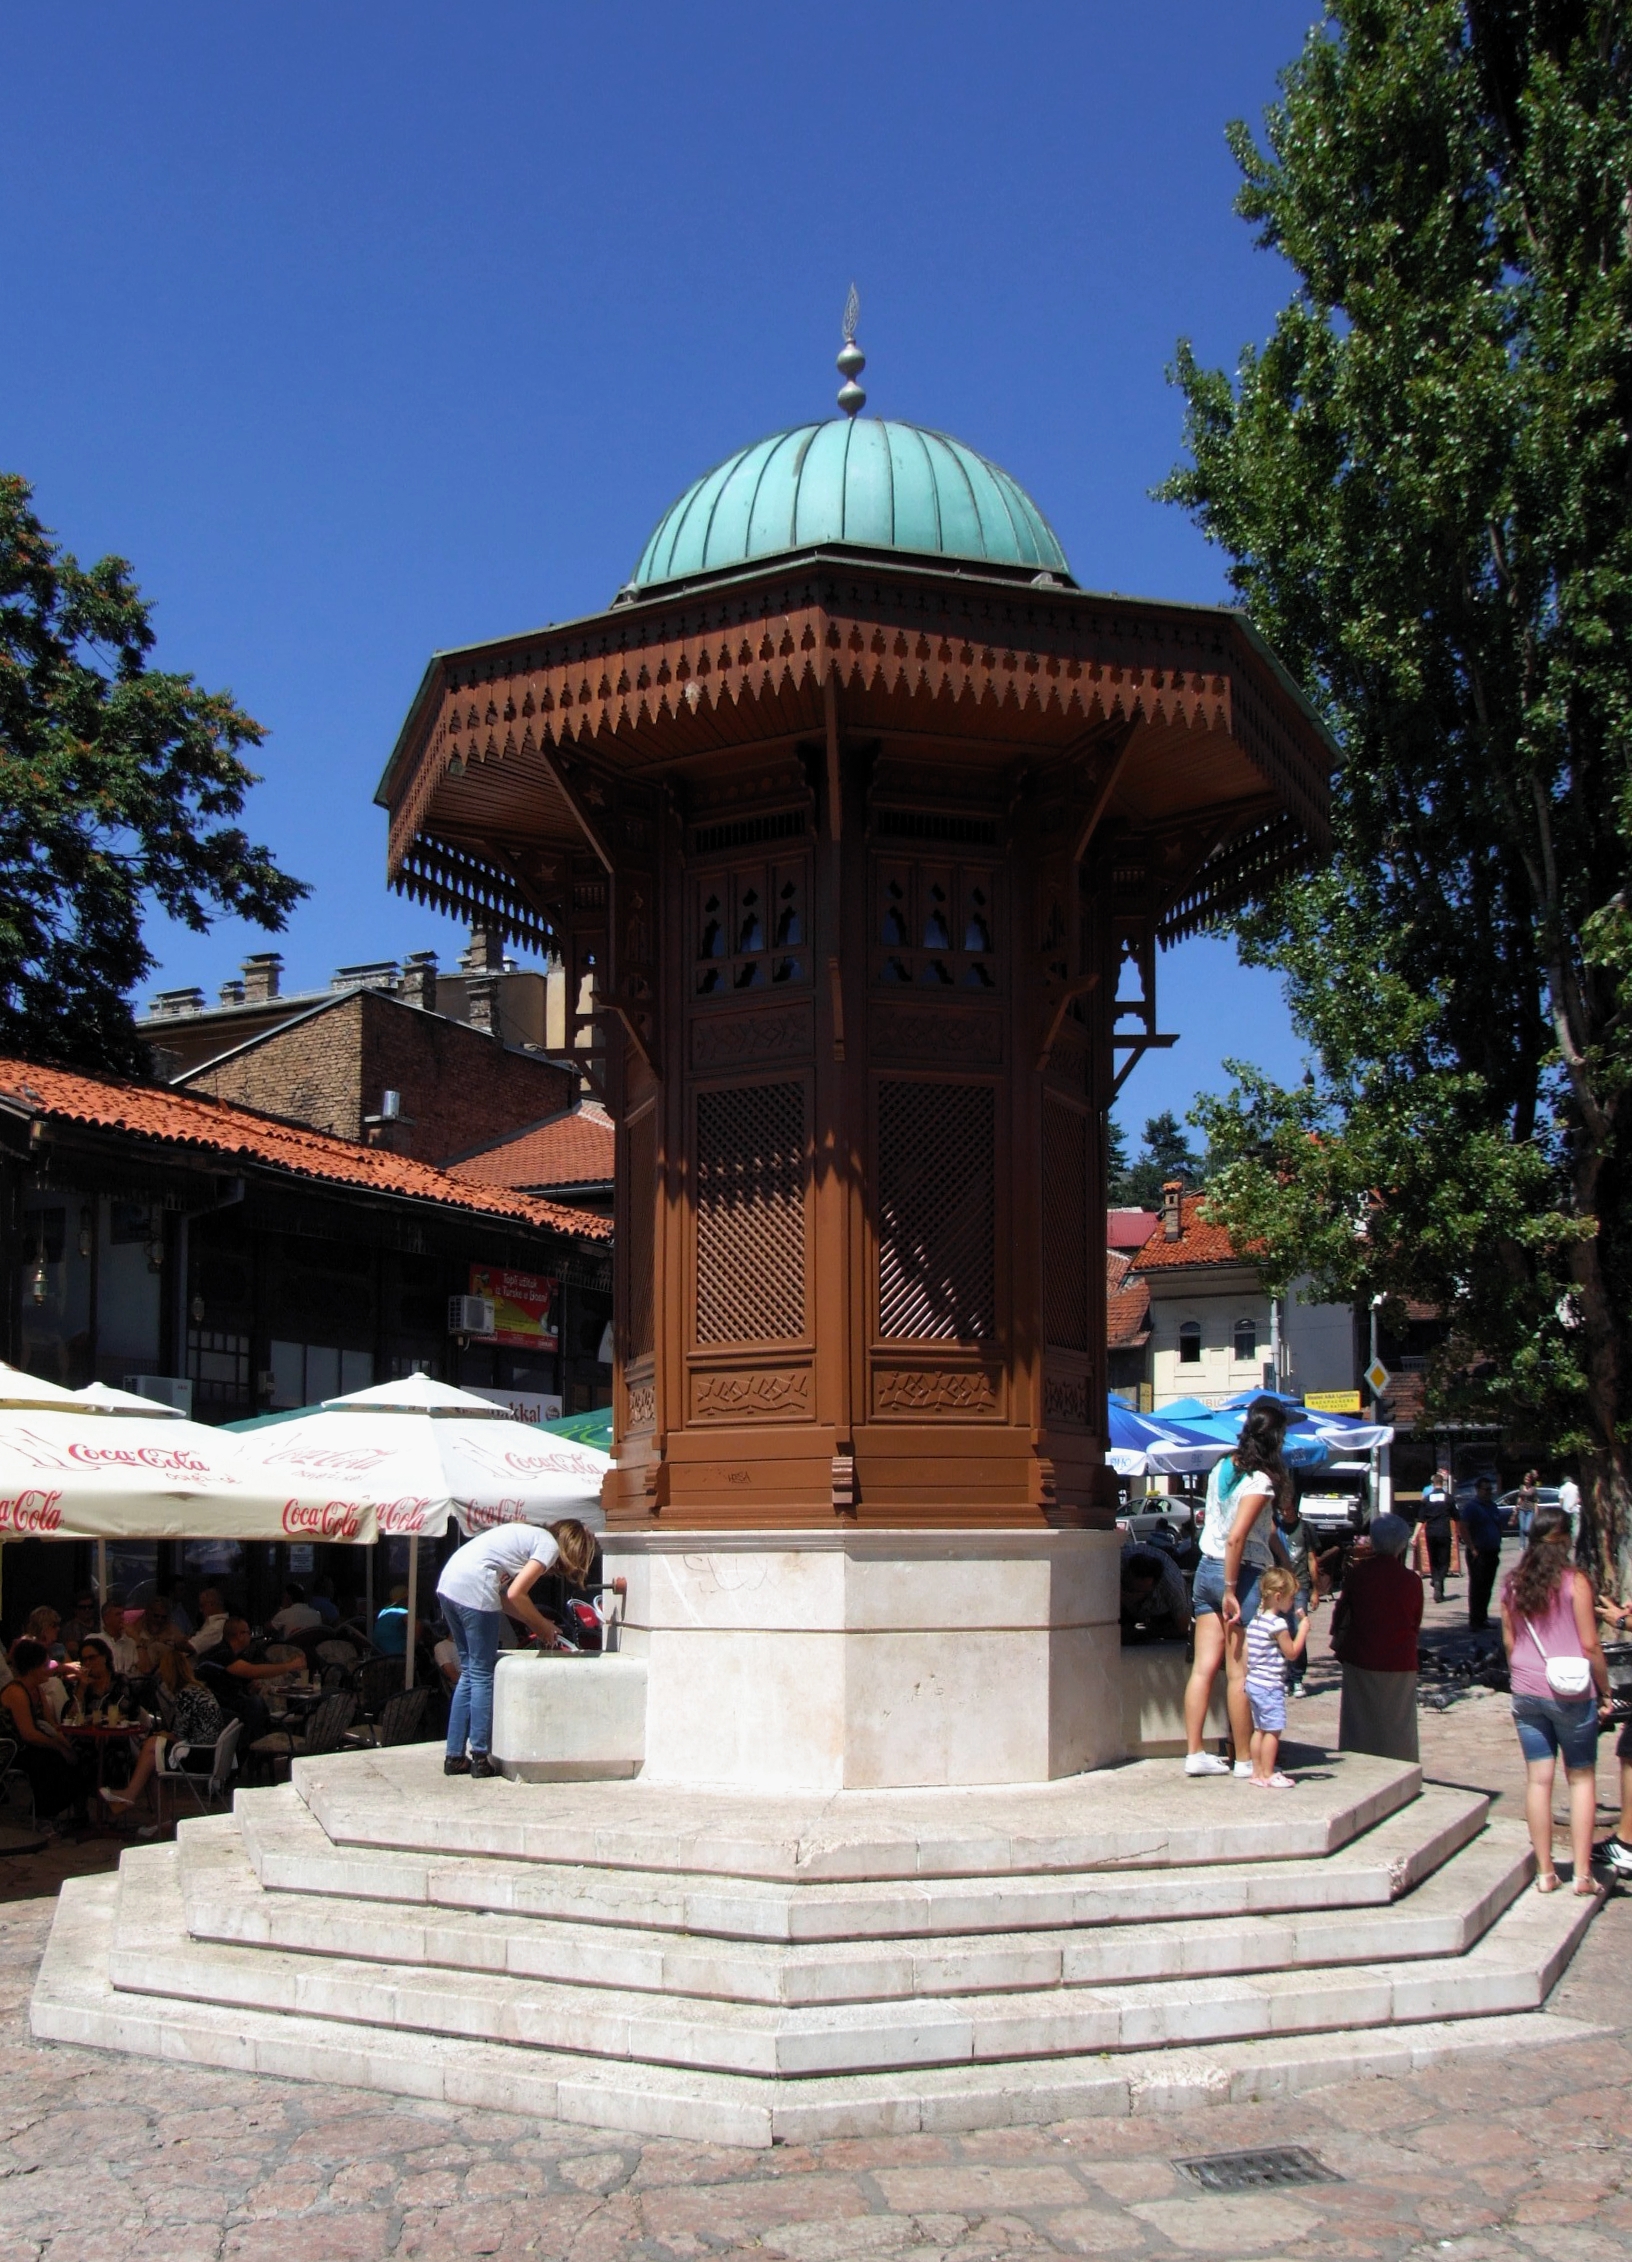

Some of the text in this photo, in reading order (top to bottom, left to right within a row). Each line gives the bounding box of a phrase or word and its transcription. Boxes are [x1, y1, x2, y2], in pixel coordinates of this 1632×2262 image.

[0, 1489, 65, 1533] a-Cola
[282, 1499, 360, 1537] Coca-Cola
[376, 1497, 431, 1532] a-Cola
